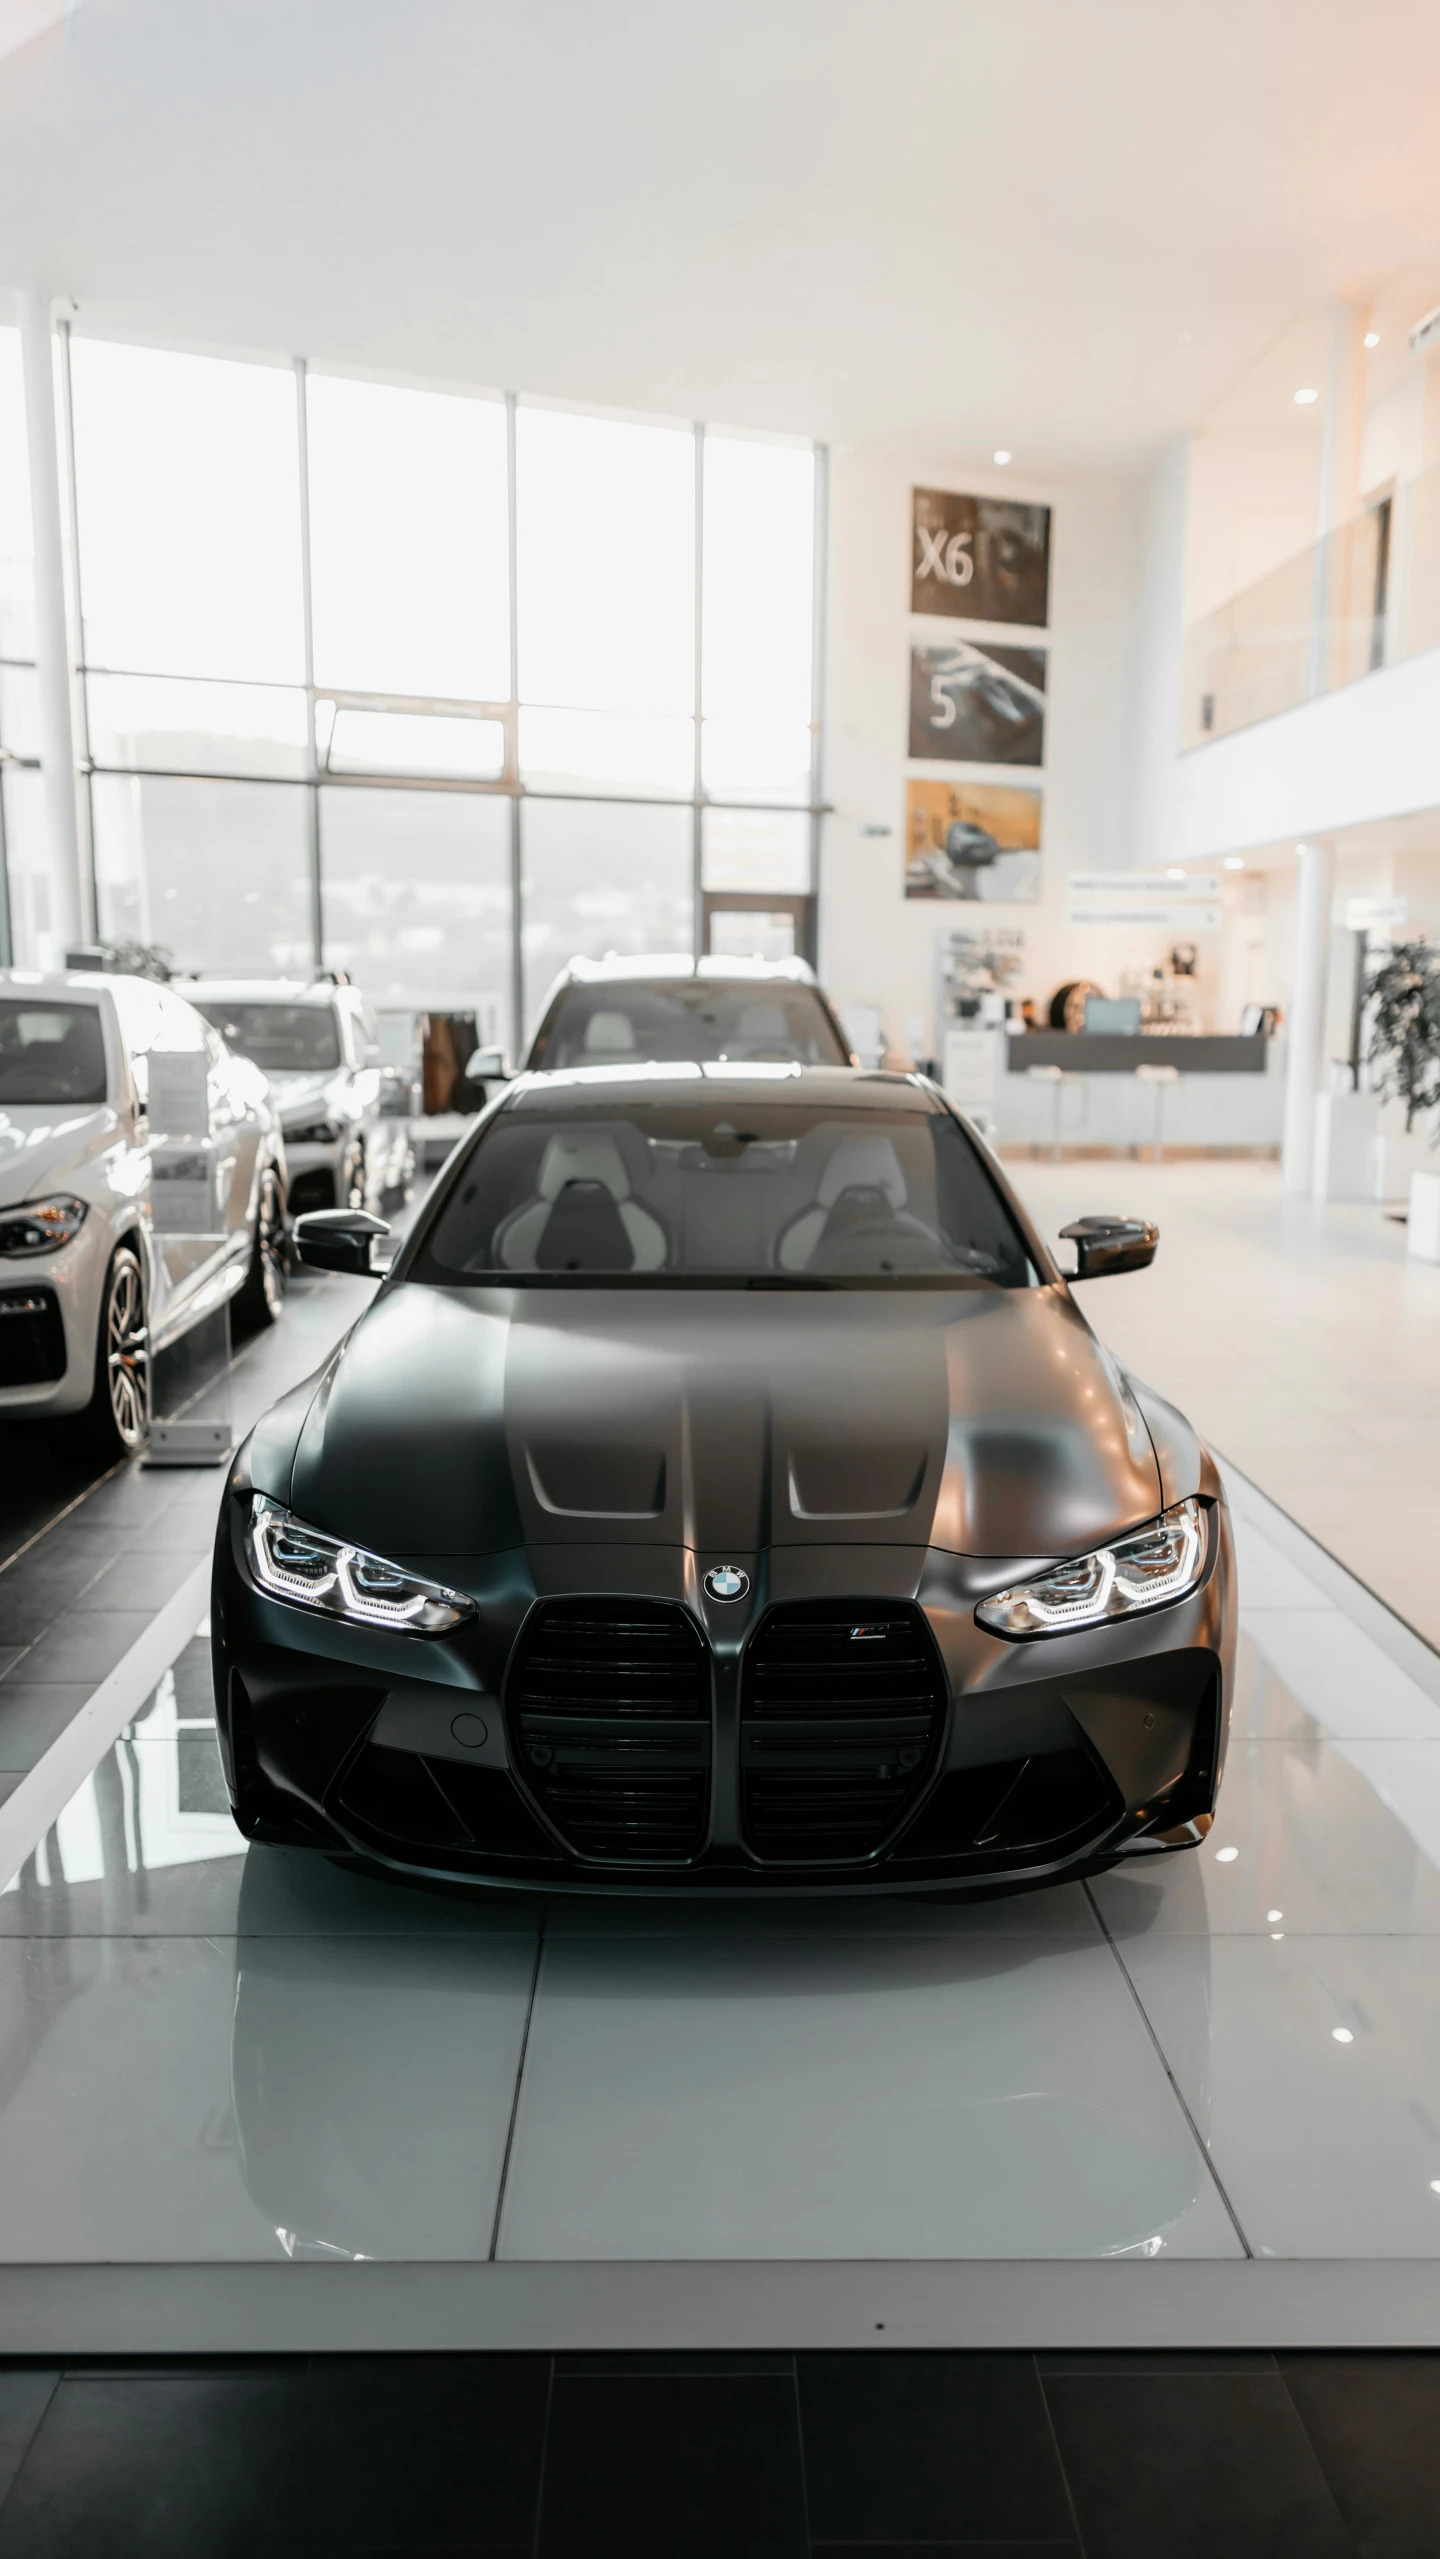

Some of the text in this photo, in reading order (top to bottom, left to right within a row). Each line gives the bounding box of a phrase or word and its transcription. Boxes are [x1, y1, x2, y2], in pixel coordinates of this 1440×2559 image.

[915, 526, 974, 587] X6
[930, 674, 957, 729] 5
[708, 1566, 746, 1578] BMW
